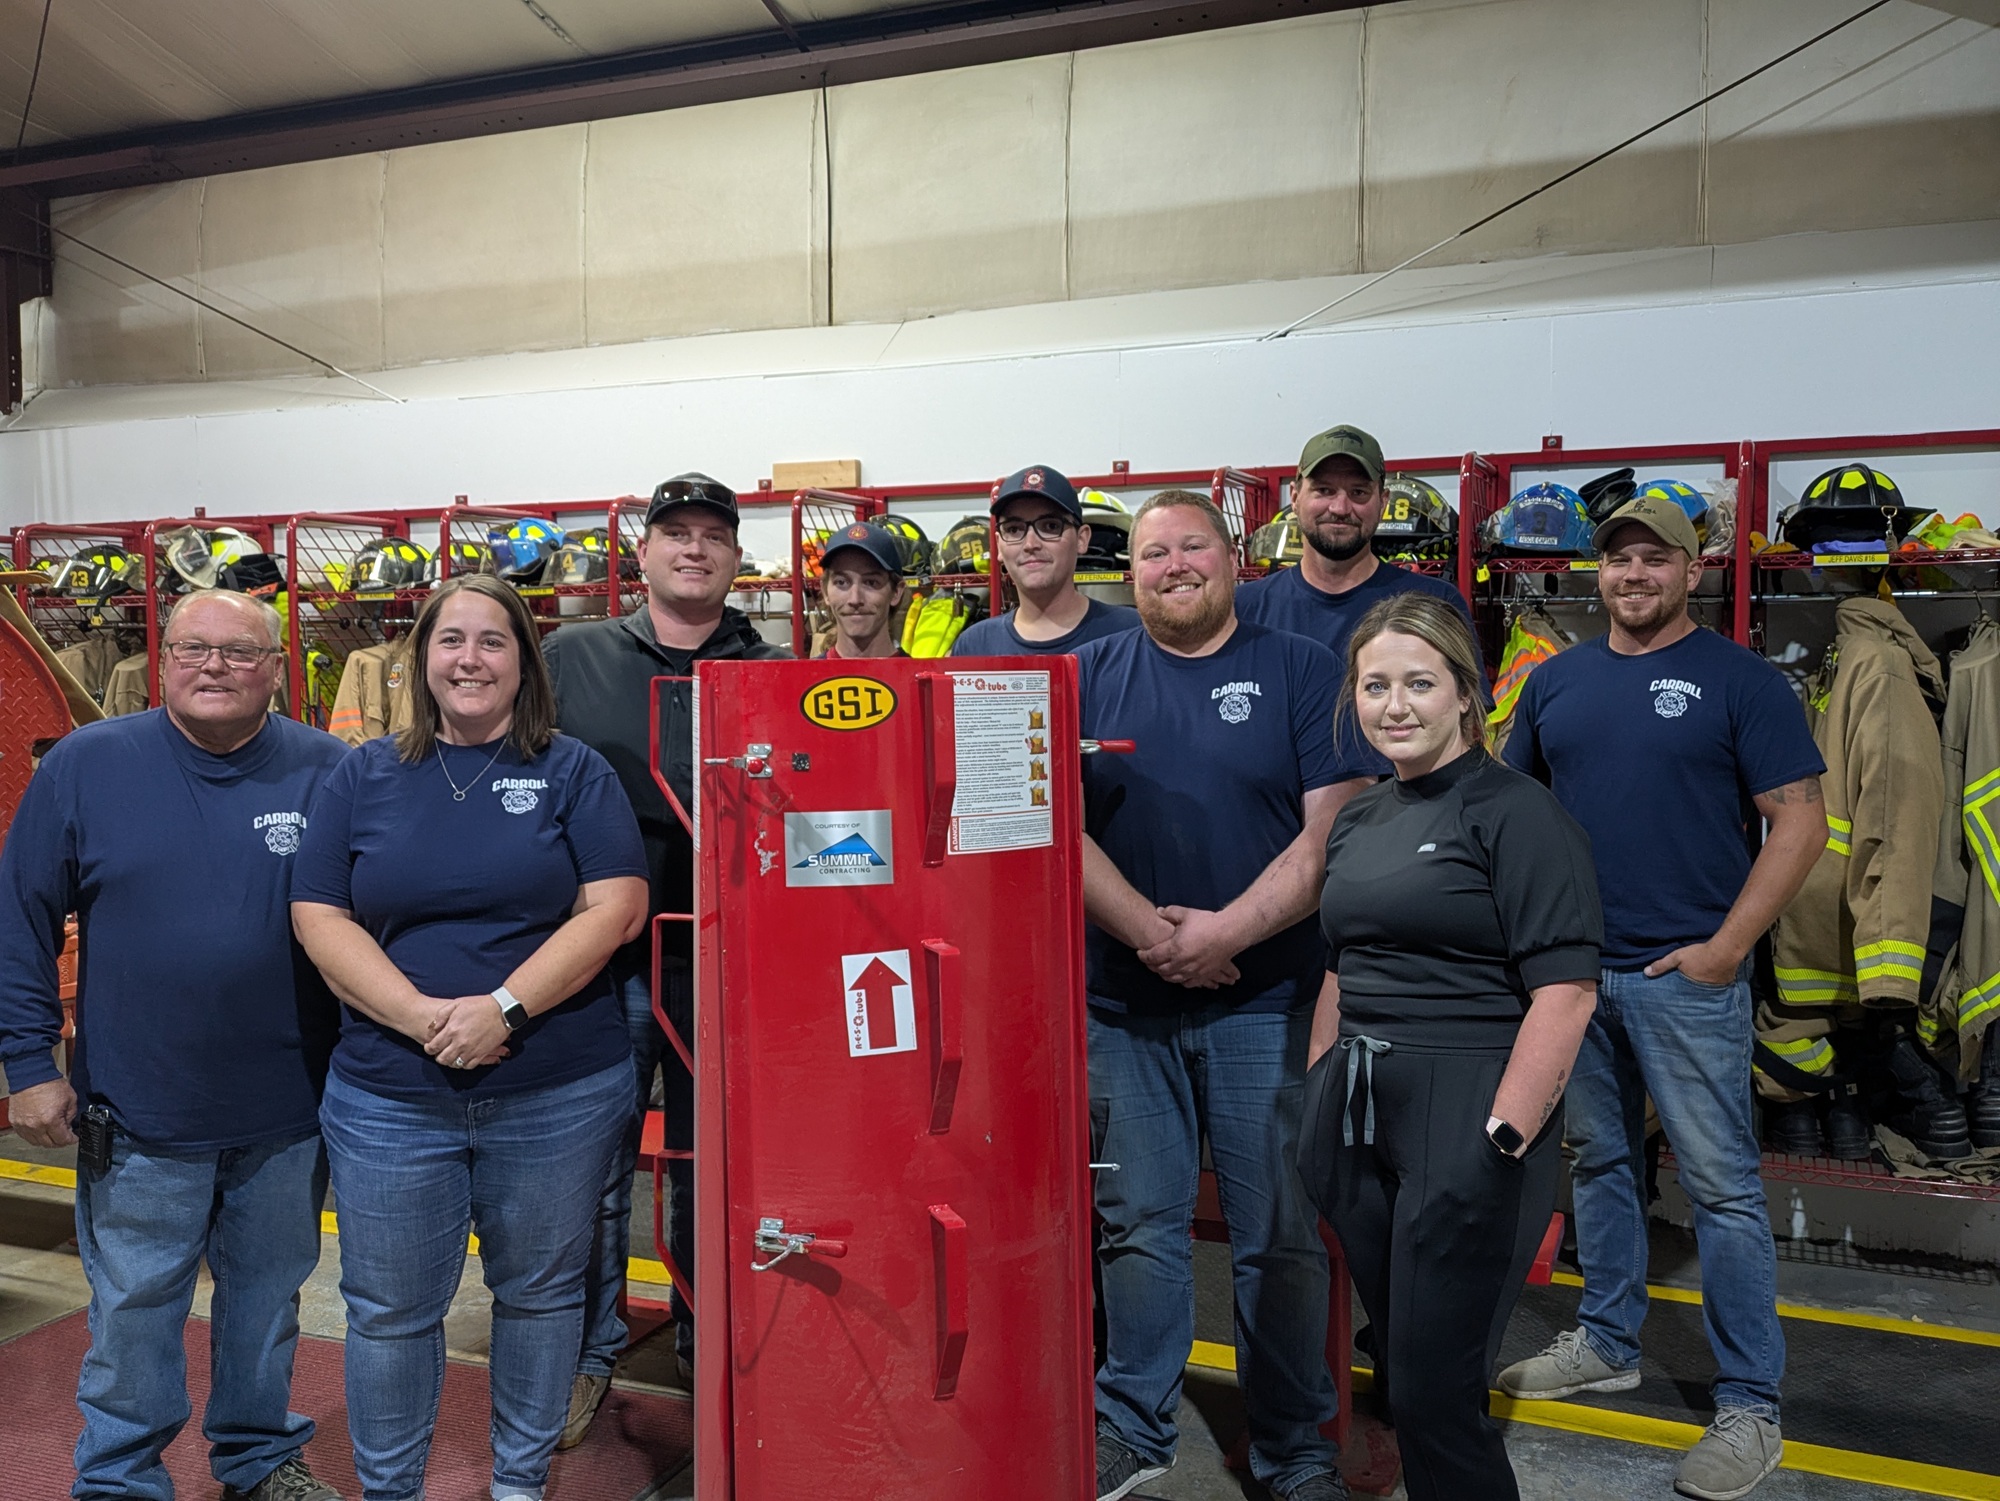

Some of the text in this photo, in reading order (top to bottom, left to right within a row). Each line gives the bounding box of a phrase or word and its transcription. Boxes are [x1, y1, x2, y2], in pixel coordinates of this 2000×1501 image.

[1382, 498, 1410, 520] 18
[960, 539, 984, 559] 26
[69, 570, 89, 587] 23
[1211, 681, 1262, 700] CARROLL
[1649, 678, 1702, 700] CARROLL
[813, 685, 884, 721] GSI
[492, 778, 549, 792] CARROLL
[807, 853, 873, 868] SUMMIT
[819, 867, 871, 875] CONTRACTING
